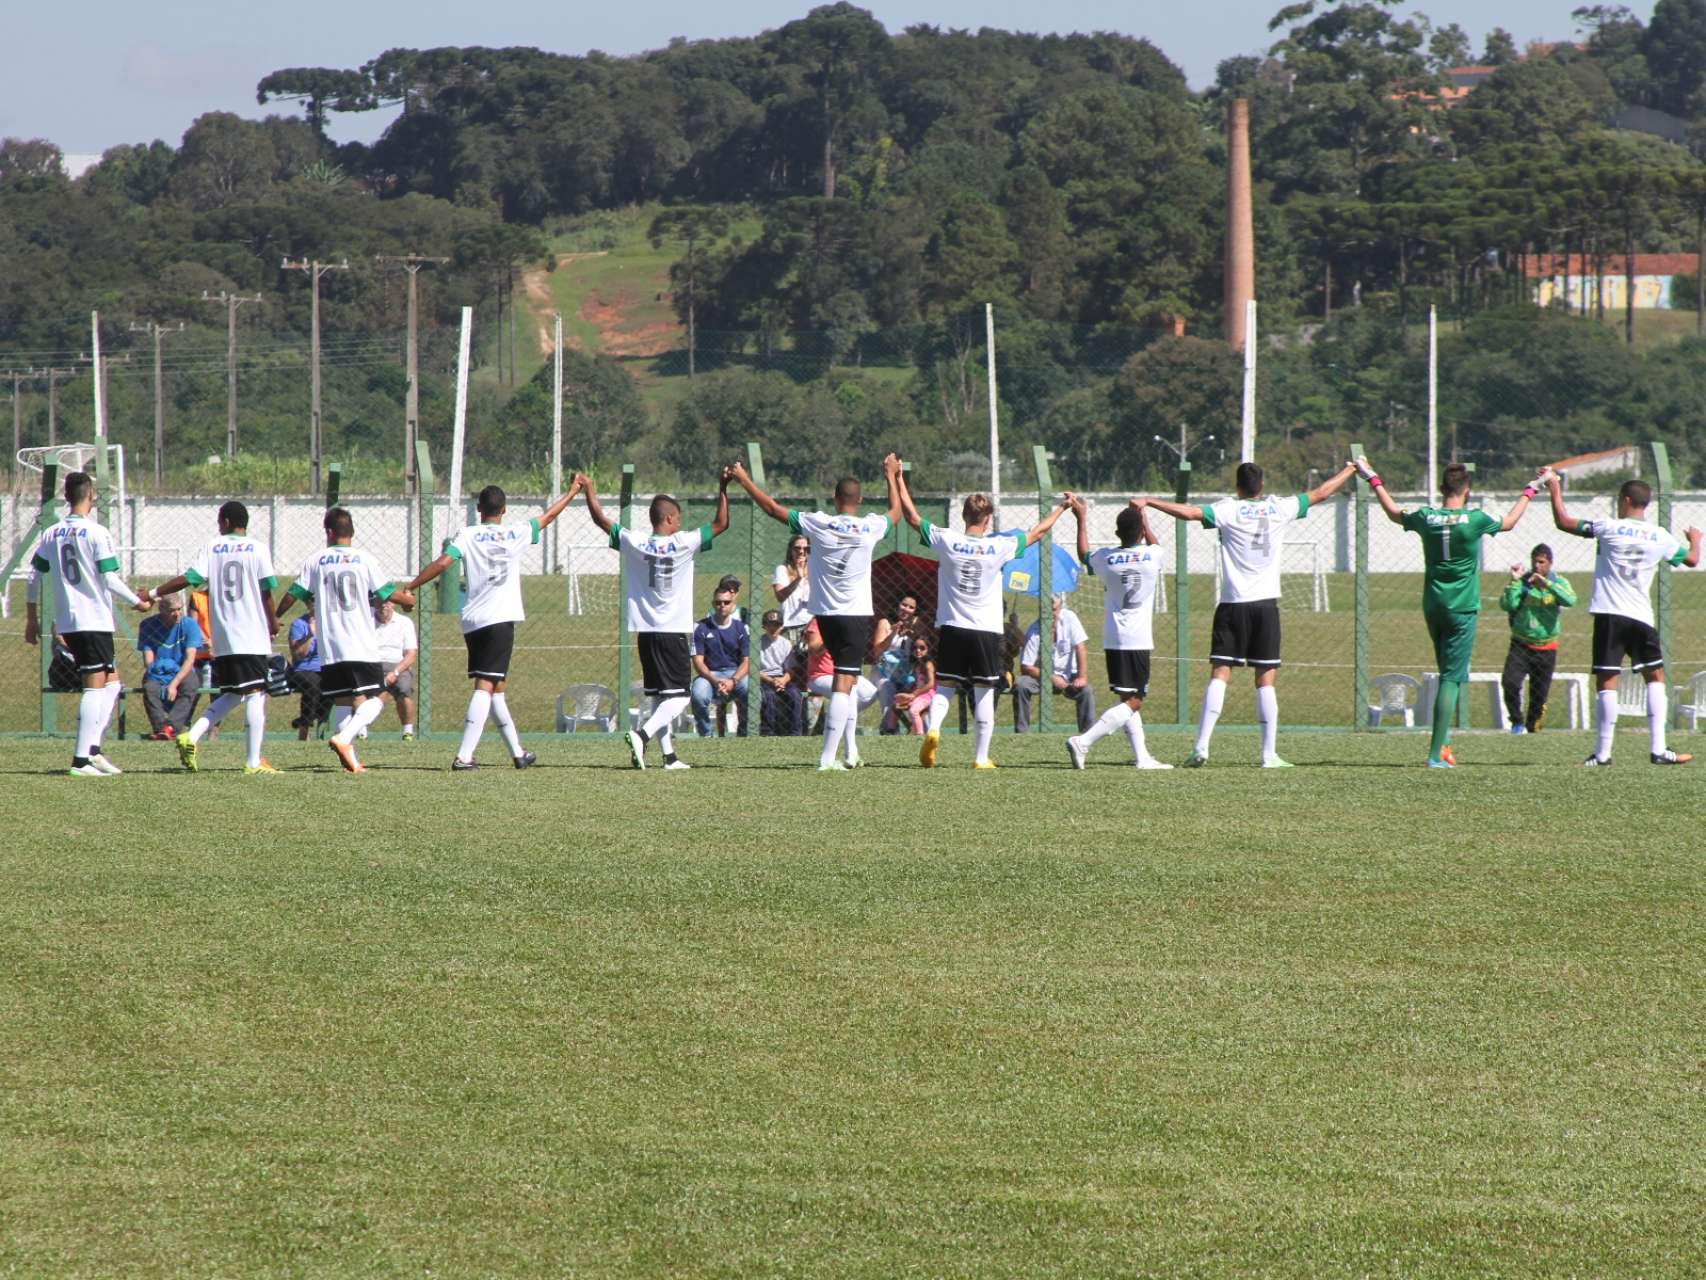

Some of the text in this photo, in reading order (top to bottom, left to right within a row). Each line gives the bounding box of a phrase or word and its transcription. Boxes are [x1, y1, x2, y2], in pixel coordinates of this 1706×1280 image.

[213, 543, 254, 554] CAIXA
[1251, 518, 1271, 557] 4
[1442, 525, 1451, 561] 1
[1617, 526, 1658, 541] CAIXA
[61, 543, 82, 586] 6
[319, 554, 361, 566] CAIXA
[487, 547, 508, 587] 5
[643, 554, 674, 592] 11
[835, 538, 860, 577] 7
[1107, 552, 1151, 565] CAIXA
[223, 560, 244, 602] 9
[323, 570, 357, 612] 10
[959, 559, 982, 597] 8
[1121, 568, 1142, 609] 2
